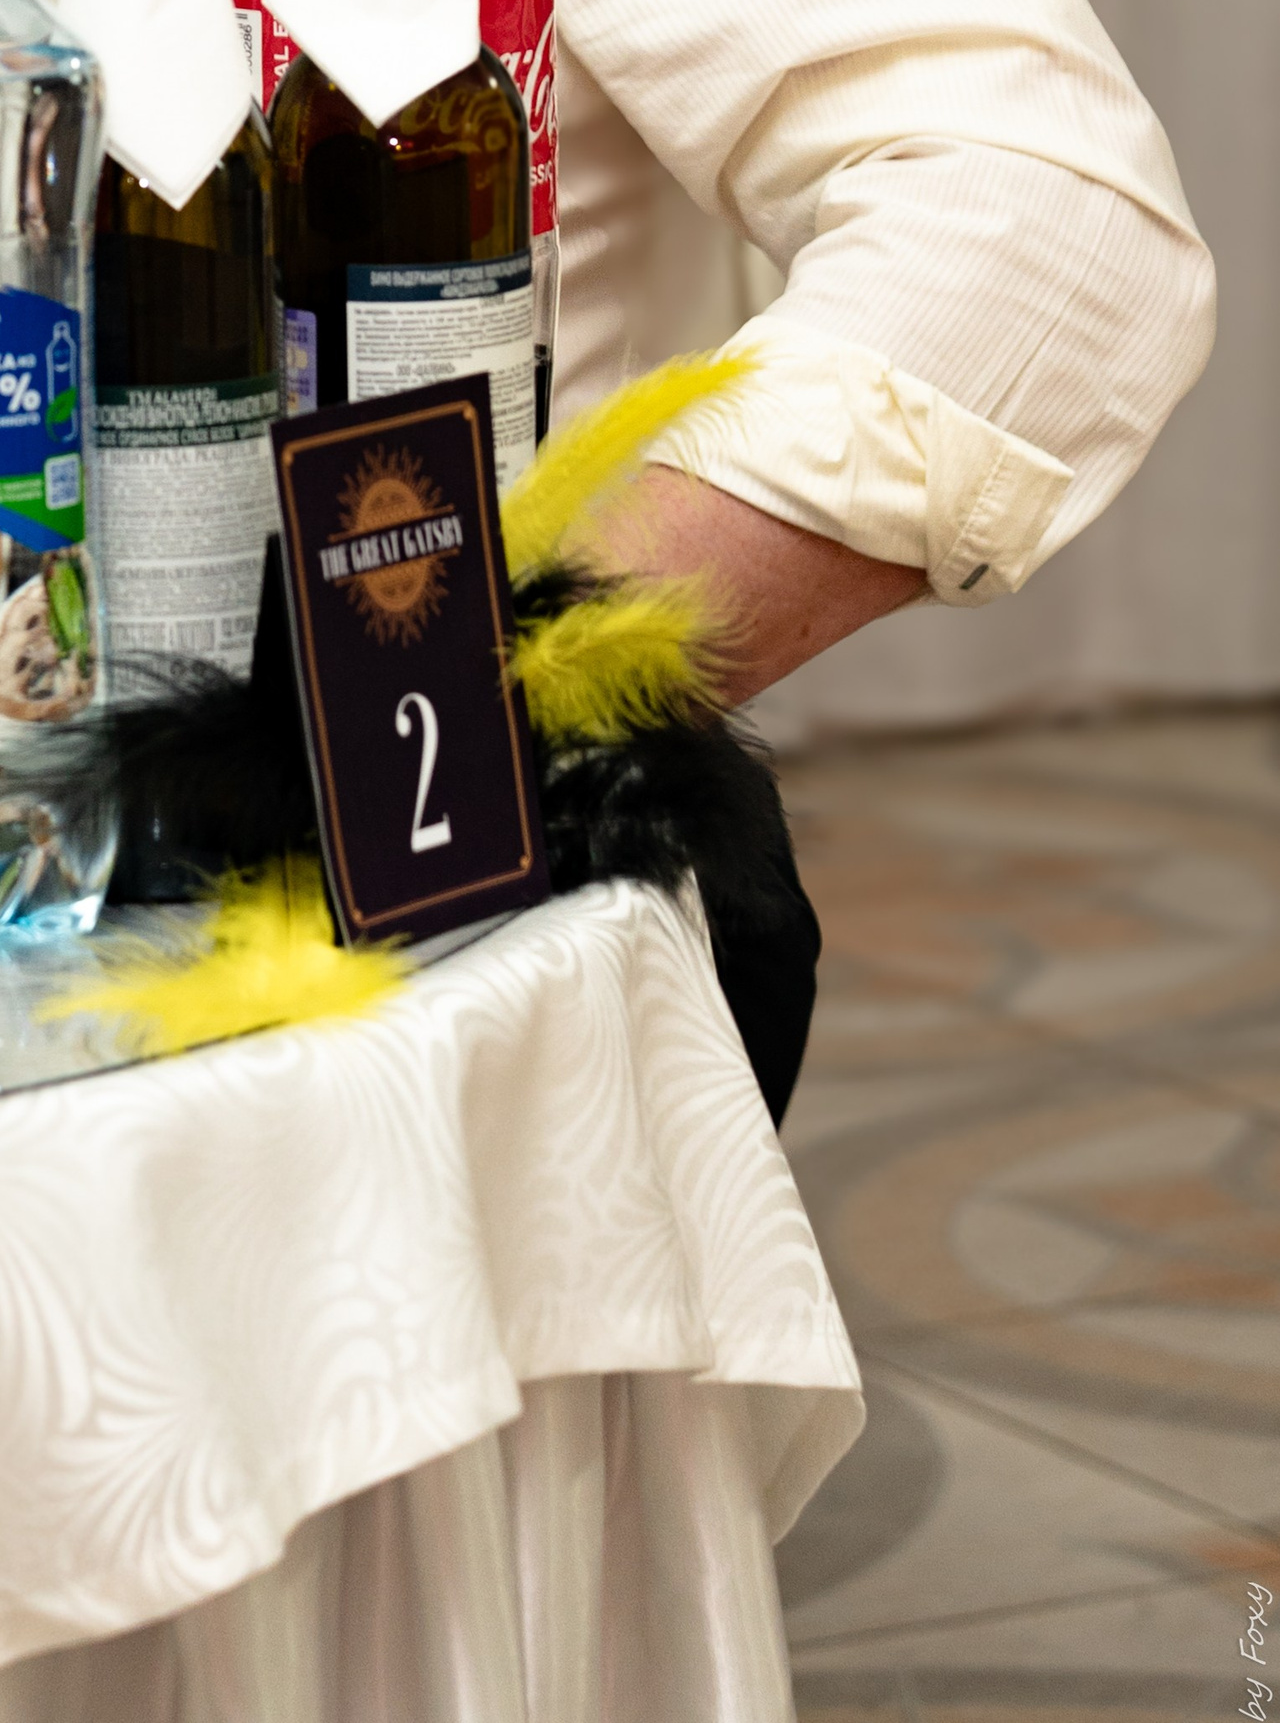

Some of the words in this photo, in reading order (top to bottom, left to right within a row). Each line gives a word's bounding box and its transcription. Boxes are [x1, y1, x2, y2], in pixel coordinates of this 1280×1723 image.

[319, 544, 349, 582] THE
[350, 530, 400, 572] GREAT
[402, 514, 463, 558] GATSBY
[395, 692, 452, 854] 2
